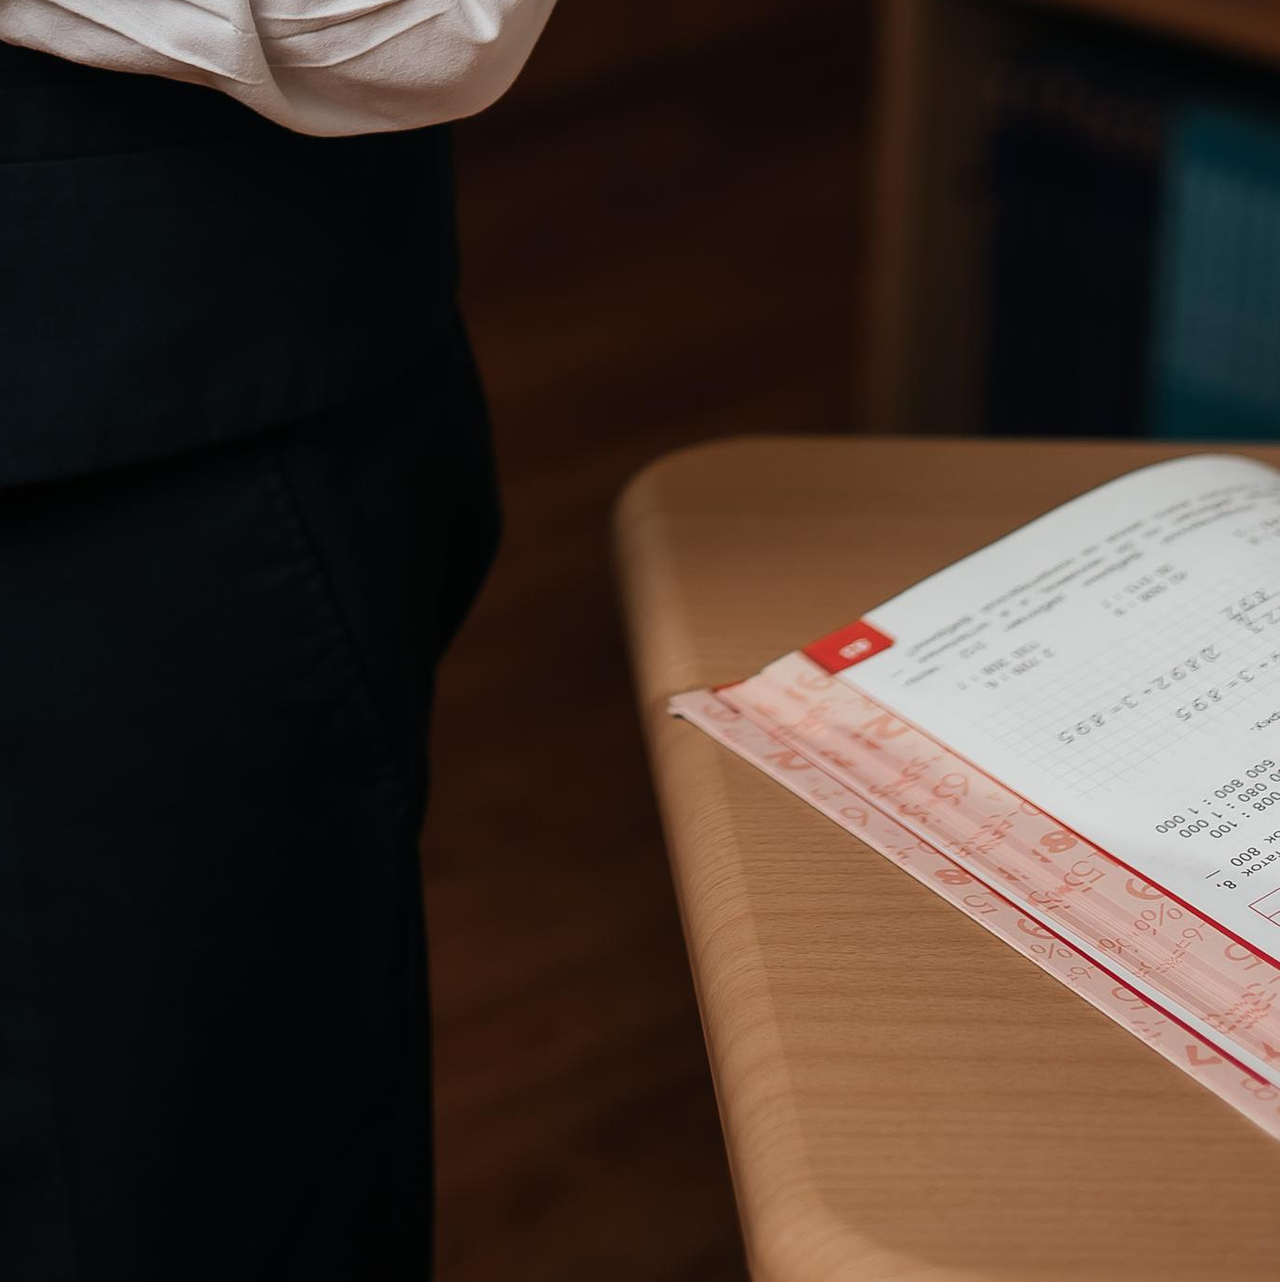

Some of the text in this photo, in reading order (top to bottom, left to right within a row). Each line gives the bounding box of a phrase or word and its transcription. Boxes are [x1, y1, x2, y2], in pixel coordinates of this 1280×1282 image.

[1246, 759, 1275, 778] 600
[1214, 779, 1243, 799] 800
[1237, 782, 1267, 802] 080
[1155, 815, 1186, 834] 000
[1179, 819, 1209, 838] 000
[1209, 820, 1237, 838] 100
[1230, 847, 1260, 866] 800
